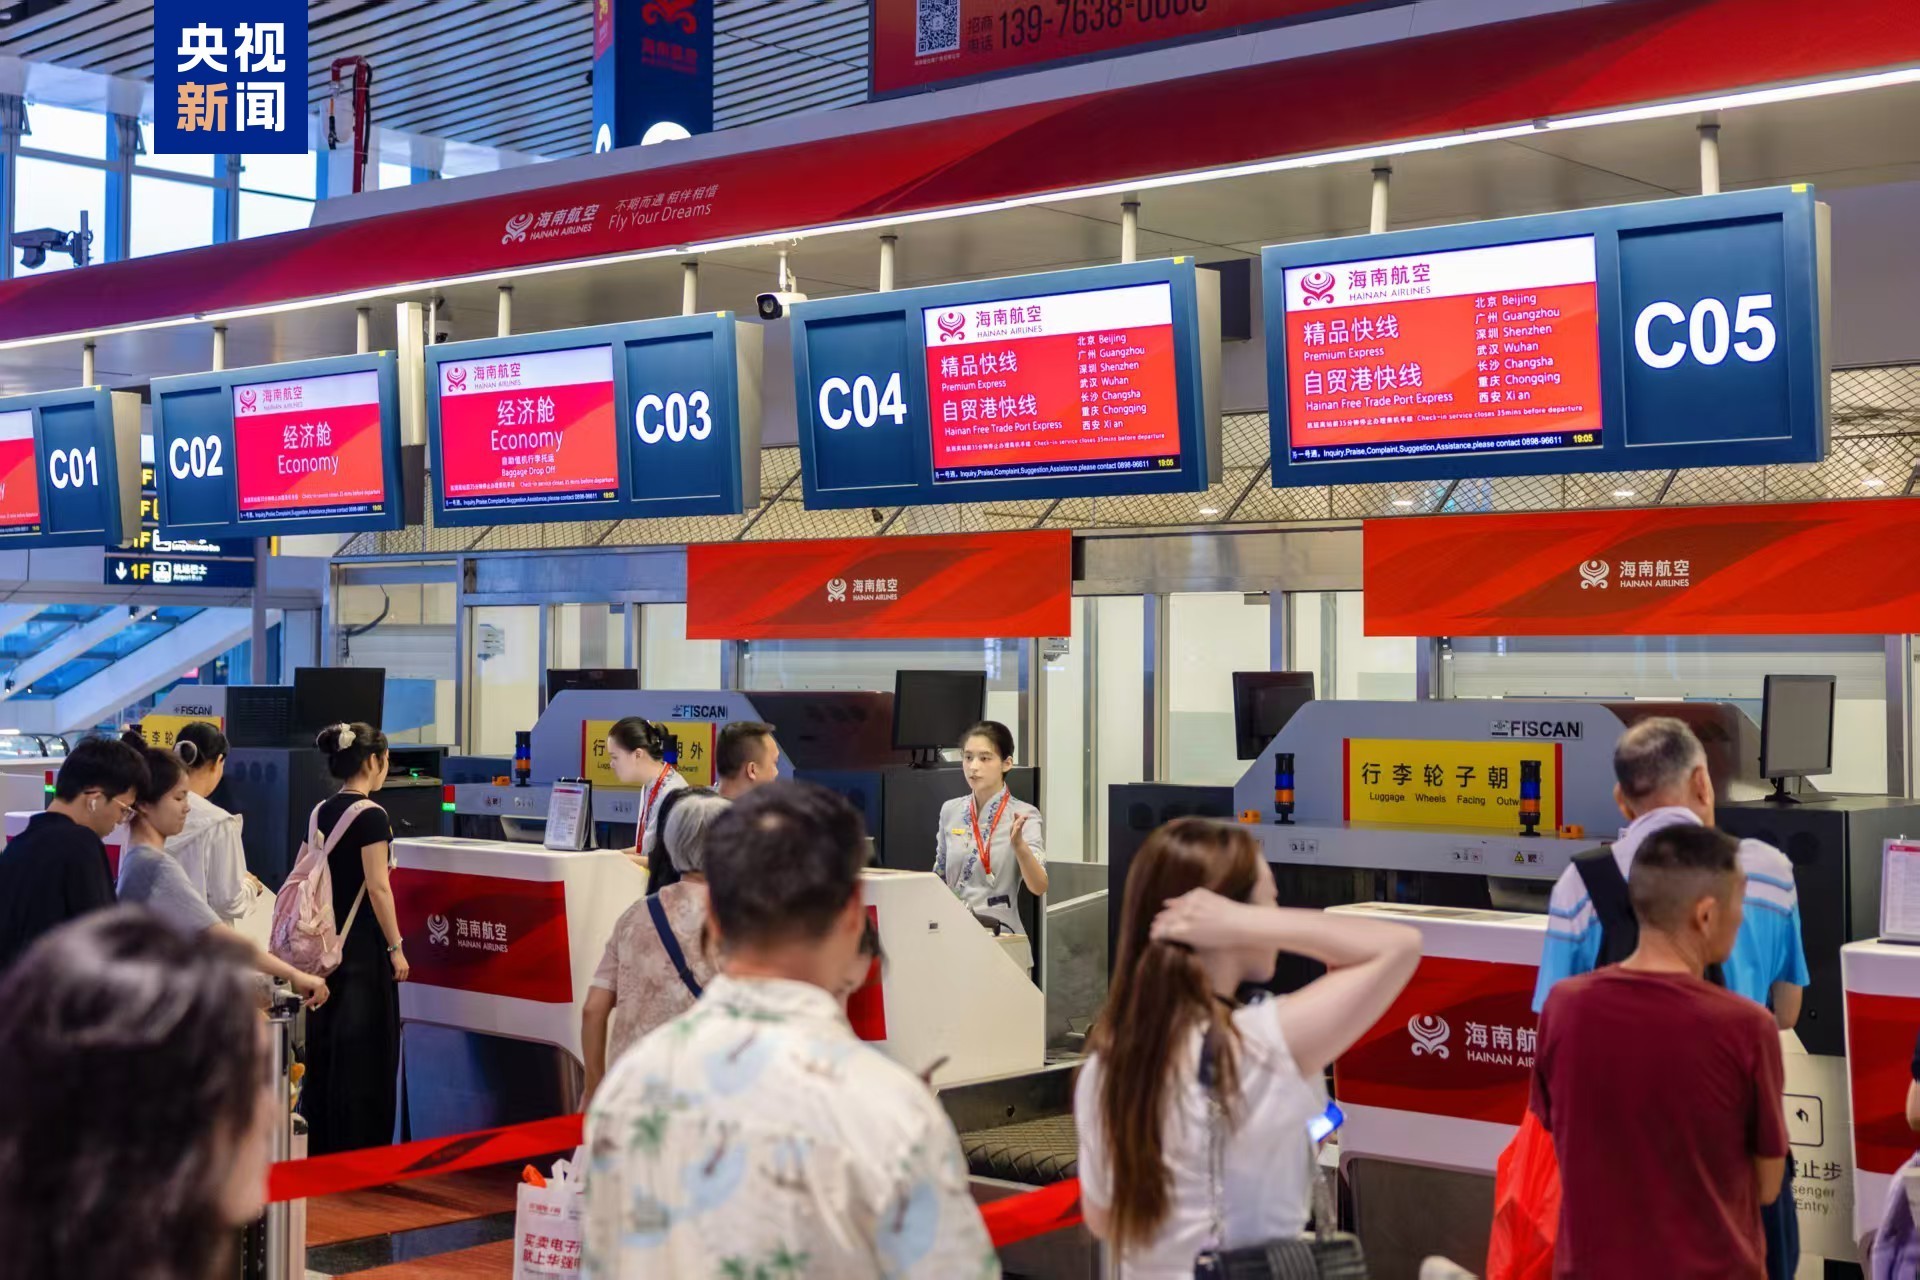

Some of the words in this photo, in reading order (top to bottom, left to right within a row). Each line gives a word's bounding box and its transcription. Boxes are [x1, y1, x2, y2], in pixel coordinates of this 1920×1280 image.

[533, 204, 600, 230] 海南航空
[609, 214, 628, 232] Fly
[631, 211, 659, 226] Your
[661, 204, 712, 221] Dreams
[530, 228, 559, 240] HAINAN
[561, 223, 592, 236] AIRLINES
[1348, 264, 1430, 290] 海南航空
[1349, 290, 1387, 301] HAINAN
[1391, 286, 1431, 297] AIRLINES
[1475, 296, 1497, 308] 北京
[1502, 294, 1537, 306] Beijing
[976, 305, 1042, 328] 海南航空
[1475, 312, 1498, 324] 广州
[1502, 308, 1560, 321] Guangzhou
[977, 329, 1007, 338] HAINAN
[1010, 325, 1042, 335] AIRLINES
[1303, 314, 1399, 347] 精品快线
[1476, 328, 1499, 340] 深圳
[1503, 325, 1552, 337] Shenzhen
[1634, 293, 1778, 369] C05
[1078, 335, 1095, 346] 北京
[1099, 334, 1126, 345] Beijing
[1078, 349, 1096, 360] 广州
[1100, 346, 1145, 358] Guangzhou
[1303, 350, 1346, 361] Premium
[1349, 347, 1385, 359] Express
[1476, 344, 1499, 356] 武汉
[1504, 341, 1539, 352] Wuhan
[474, 362, 521, 381] 海南航空
[941, 350, 1018, 378] 精品快线
[1079, 364, 1097, 374] 深圳
[1100, 361, 1139, 372] Shenzhen
[1477, 360, 1500, 372] 长沙
[1504, 356, 1554, 370] Changsha
[942, 381, 976, 391] Premium
[978, 380, 1007, 390] Express
[1080, 378, 1098, 388] 武汉
[1101, 376, 1129, 386] Wuhan
[1304, 362, 1423, 396] 自贸港快线
[1478, 376, 1501, 388] 重庆
[1505, 372, 1561, 385] Chongqing
[263, 386, 302, 403] 海南航空
[819, 372, 907, 430] C04
[1081, 392, 1099, 402] 长沙
[1102, 389, 1141, 401] Changsha
[1306, 400, 1339, 411] Hainan
[1341, 398, 1361, 409] Free
[1364, 396, 1391, 407] Trade
[1393, 394, 1414, 405] Port
[1416, 392, 1453, 404] Express
[1478, 391, 1501, 403] 西安
[497, 395, 555, 426] 经济舱
[943, 394, 1038, 422] 自贸港快线
[1081, 406, 1099, 416] 重庆
[1103, 404, 1147, 415] Chongqing
[1449, 412, 1473, 420] service
[1523, 407, 1546, 415] before
[1548, 405, 1583, 414] departure
[636, 390, 712, 444] C03
[1082, 420, 1100, 430] 西安
[283, 421, 331, 450] 经济舱
[945, 427, 972, 436] Hainan
[973, 425, 990, 434] Free
[991, 423, 1013, 433] Trade
[1014, 422, 1031, 431] Port
[1032, 421, 1063, 431] Express
[491, 430, 564, 452] Economy
[1496, 438, 1520, 447] contact
[1521, 436, 1562, 446] 0898-96611
[1573, 434, 1593, 443] 19:05
[169, 434, 223, 480] C02
[278, 454, 339, 475] Economy
[1158, 459, 1174, 467] 19:05
[50, 446, 99, 489] C01
[502, 468, 528, 478] Baggage
[528, 467, 544, 475] Drop
[545, 465, 556, 473] Off
[1097, 462, 1116, 470] contact
[131, 563, 150, 579] 1F
[1619, 559, 1690, 578] 海南航空
[852, 578, 898, 593] 海南航空
[1620, 580, 1653, 588] HAINAN
[1655, 579, 1690, 587] AIRLINES
[181, 705, 211, 715] FISCAN
[683, 704, 726, 718] FISCAN
[1510, 721, 1580, 738] FISCAN
[593, 738, 605, 757] 行
[1361, 762, 1509, 789] 行李轮子朝
[1369, 792, 1405, 803] Luggage
[1415, 793, 1447, 803] Wheels
[1457, 795, 1486, 806] Facing
[1496, 796, 1519, 806] Outw
[456, 917, 508, 942] 海南航空
[458, 940, 481, 949] HAINAN
[483, 943, 509, 953] AIRLINES
[1465, 1021, 1537, 1053] 海南航
[1467, 1050, 1512, 1066] HAINAN
[1517, 1056, 1535, 1068] AIR
[1792, 1185, 1834, 1199] senger
[1796, 1199, 1830, 1214] Entry
